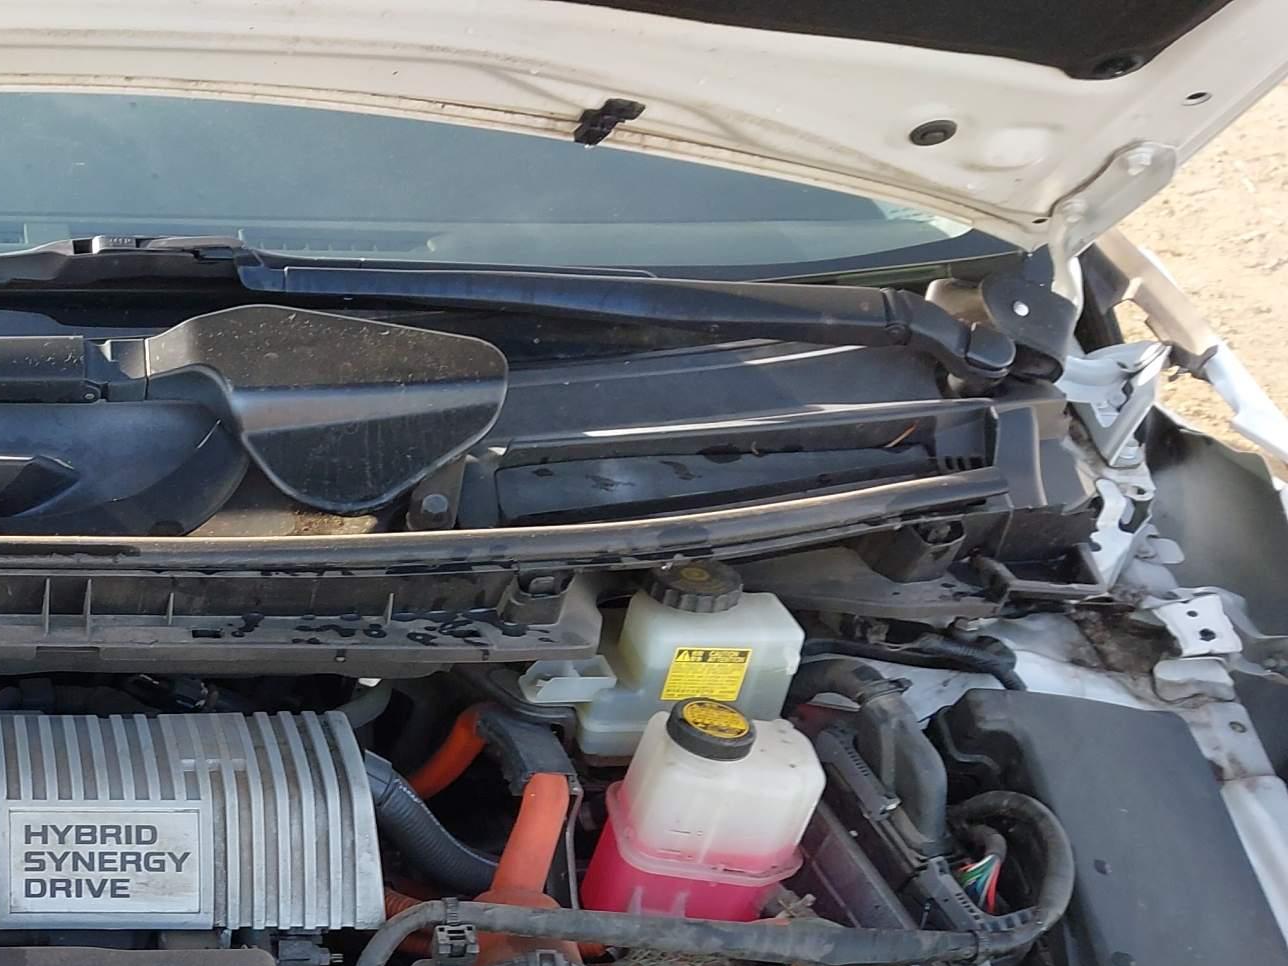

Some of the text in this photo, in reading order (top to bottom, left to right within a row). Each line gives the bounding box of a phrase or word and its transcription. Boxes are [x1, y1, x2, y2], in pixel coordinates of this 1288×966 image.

[23, 824, 158, 846] HYBRID
[23, 851, 192, 873] SYNERGY
[23, 878, 131, 900] DRIVE
